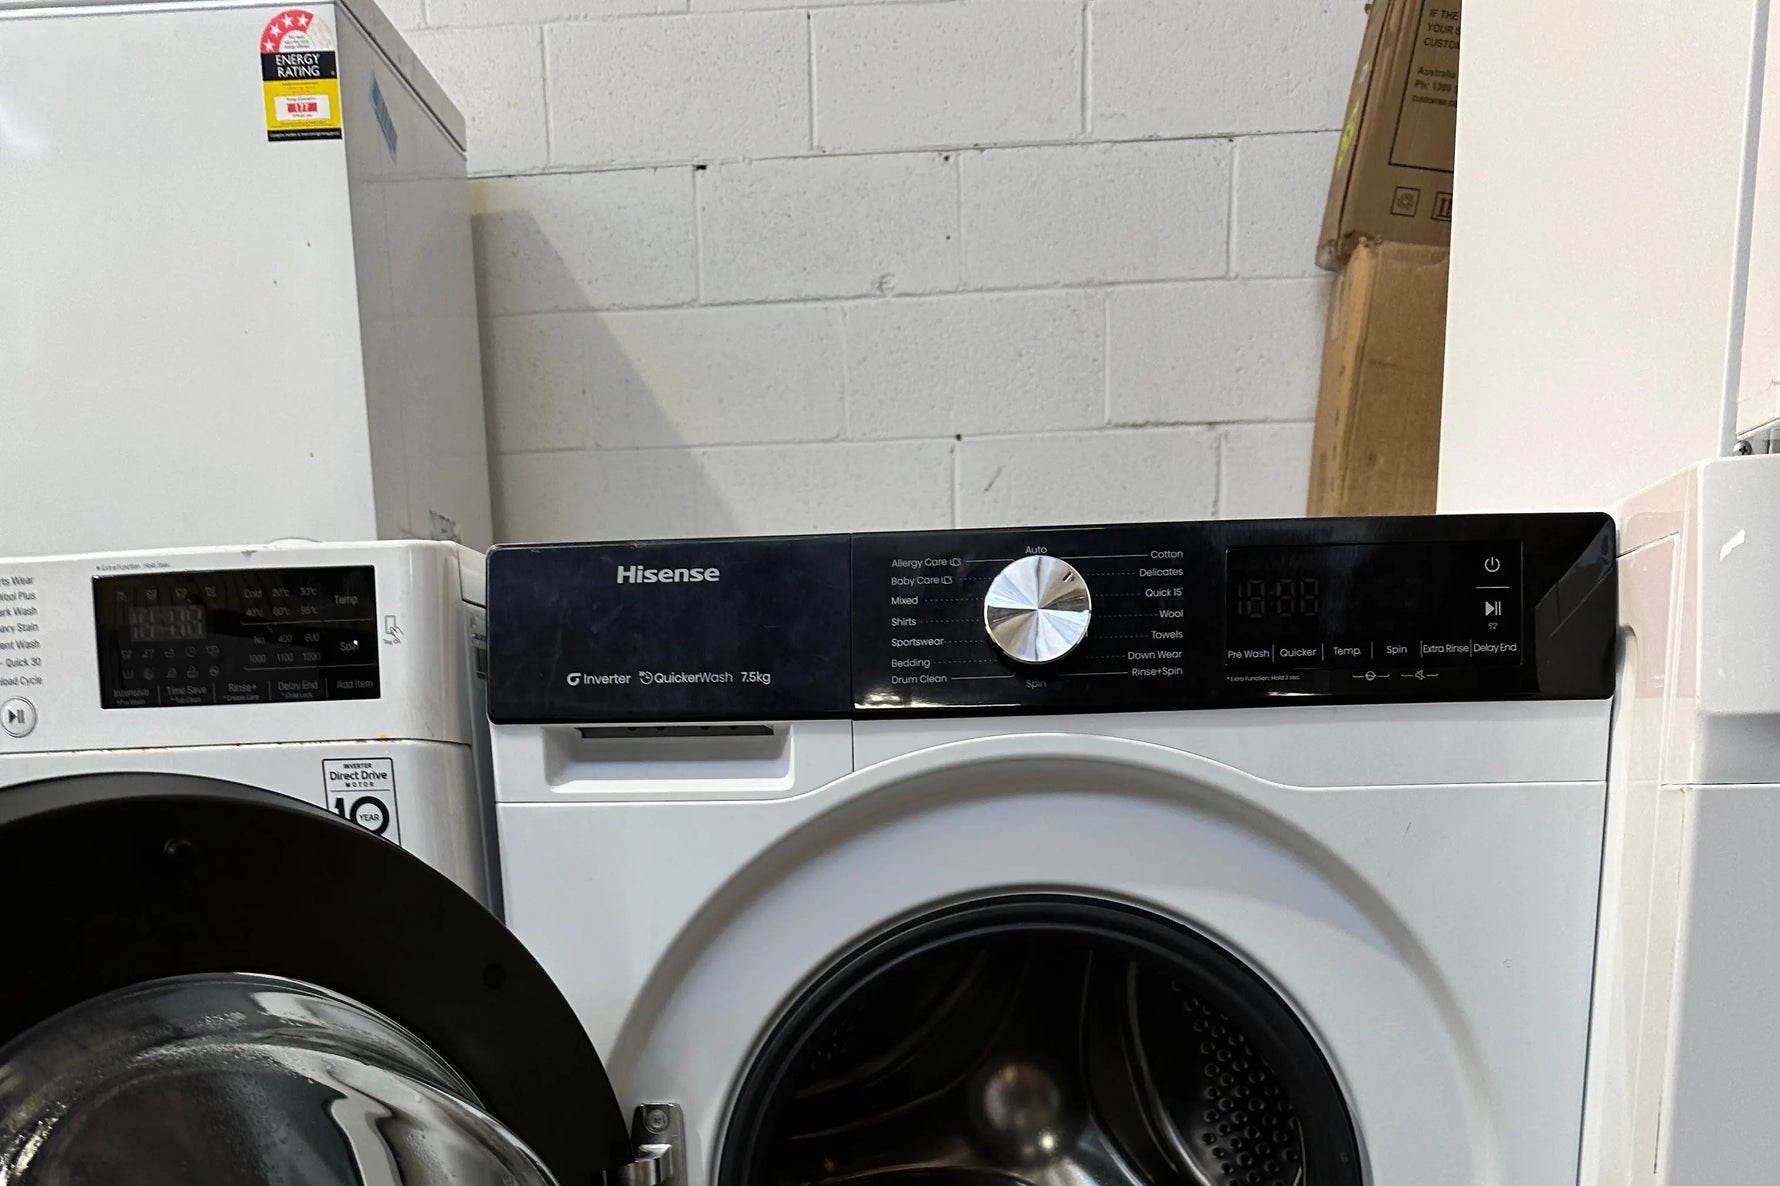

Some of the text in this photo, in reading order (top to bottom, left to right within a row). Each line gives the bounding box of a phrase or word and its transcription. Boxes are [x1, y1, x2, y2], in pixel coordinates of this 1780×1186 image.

[1441, 9, 1459, 20] THE
[1427, 23, 1453, 35] YOUR
[275, 53, 321, 67] ENERGY
[277, 65, 321, 78] RATING
[1025, 546, 1048, 554] Auto
[1150, 550, 1184, 559] Cotton
[891, 558, 948, 569] Allergy Care
[616, 565, 721, 584] Hisense
[1139, 568, 1184, 577] Delicates
[891, 576, 940, 587] Baby Care
[17, 591, 37, 601] Plus
[1145, 587, 1172, 598] Quick
[891, 596, 919, 605] Mixed
[13, 606, 38, 616] Wash
[1159, 609, 1184, 618] Wool
[17, 623, 39, 632] Stain
[891, 617, 917, 627] Shirts
[1151, 630, 1184, 639] Towels
[16, 639, 41, 649] Wash
[891, 638, 944, 649] Sportswear
[1423, 643, 1470, 654] Extra Rinse
[1473, 642, 1518, 654] Delay End
[1127, 650, 1183, 660] Down Wear
[1227, 649, 1270, 659] Pre Wash
[1279, 647, 1317, 658] Quicker
[1332, 646, 1362, 657] Temp.
[1386, 645, 1408, 656] Spin
[891, 659, 931, 668] Bedding
[1131, 666, 1184, 677] Rinse+Spin
[583, 671, 772, 685] Inverter QuickerWash 7.5kg
[891, 674, 948, 684] Drum Clean
[337, 680, 354, 689] Add
[1026, 679, 1047, 690] Spin
[330, 770, 388, 781] Direct Drive
[359, 813, 380, 822] YEAR
